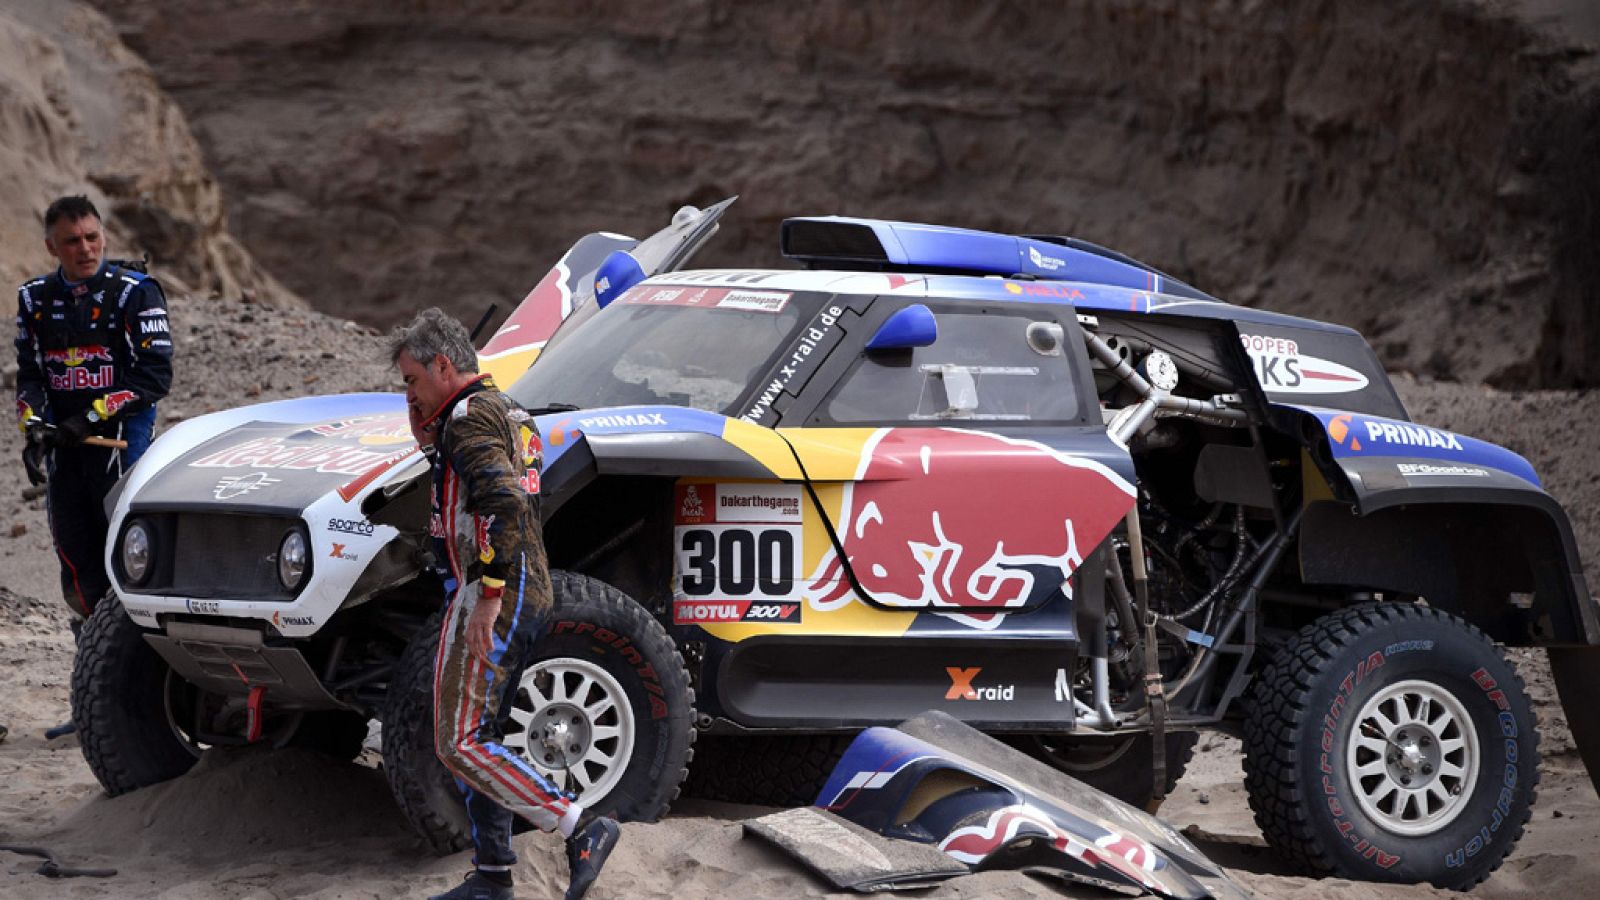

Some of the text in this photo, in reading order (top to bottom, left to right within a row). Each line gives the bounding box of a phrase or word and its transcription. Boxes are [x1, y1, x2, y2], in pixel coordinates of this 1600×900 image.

[747, 305, 842, 420] www.x-raid.de
[75, 365, 113, 389] Bull
[579, 413, 668, 429] PRIMAX
[1364, 421, 1463, 451] PRIMAX
[1397, 463, 1489, 478] BFGoodrich
[720, 494, 799, 510] Dakarthegame
[781, 508, 799, 516] .com
[328, 518, 374, 535] sparco
[682, 529, 794, 596] 300
[677, 605, 798, 619] MOTUL 300V
[944, 667, 1015, 701] X-raid
[1445, 667, 1519, 869] BFGoodrich
